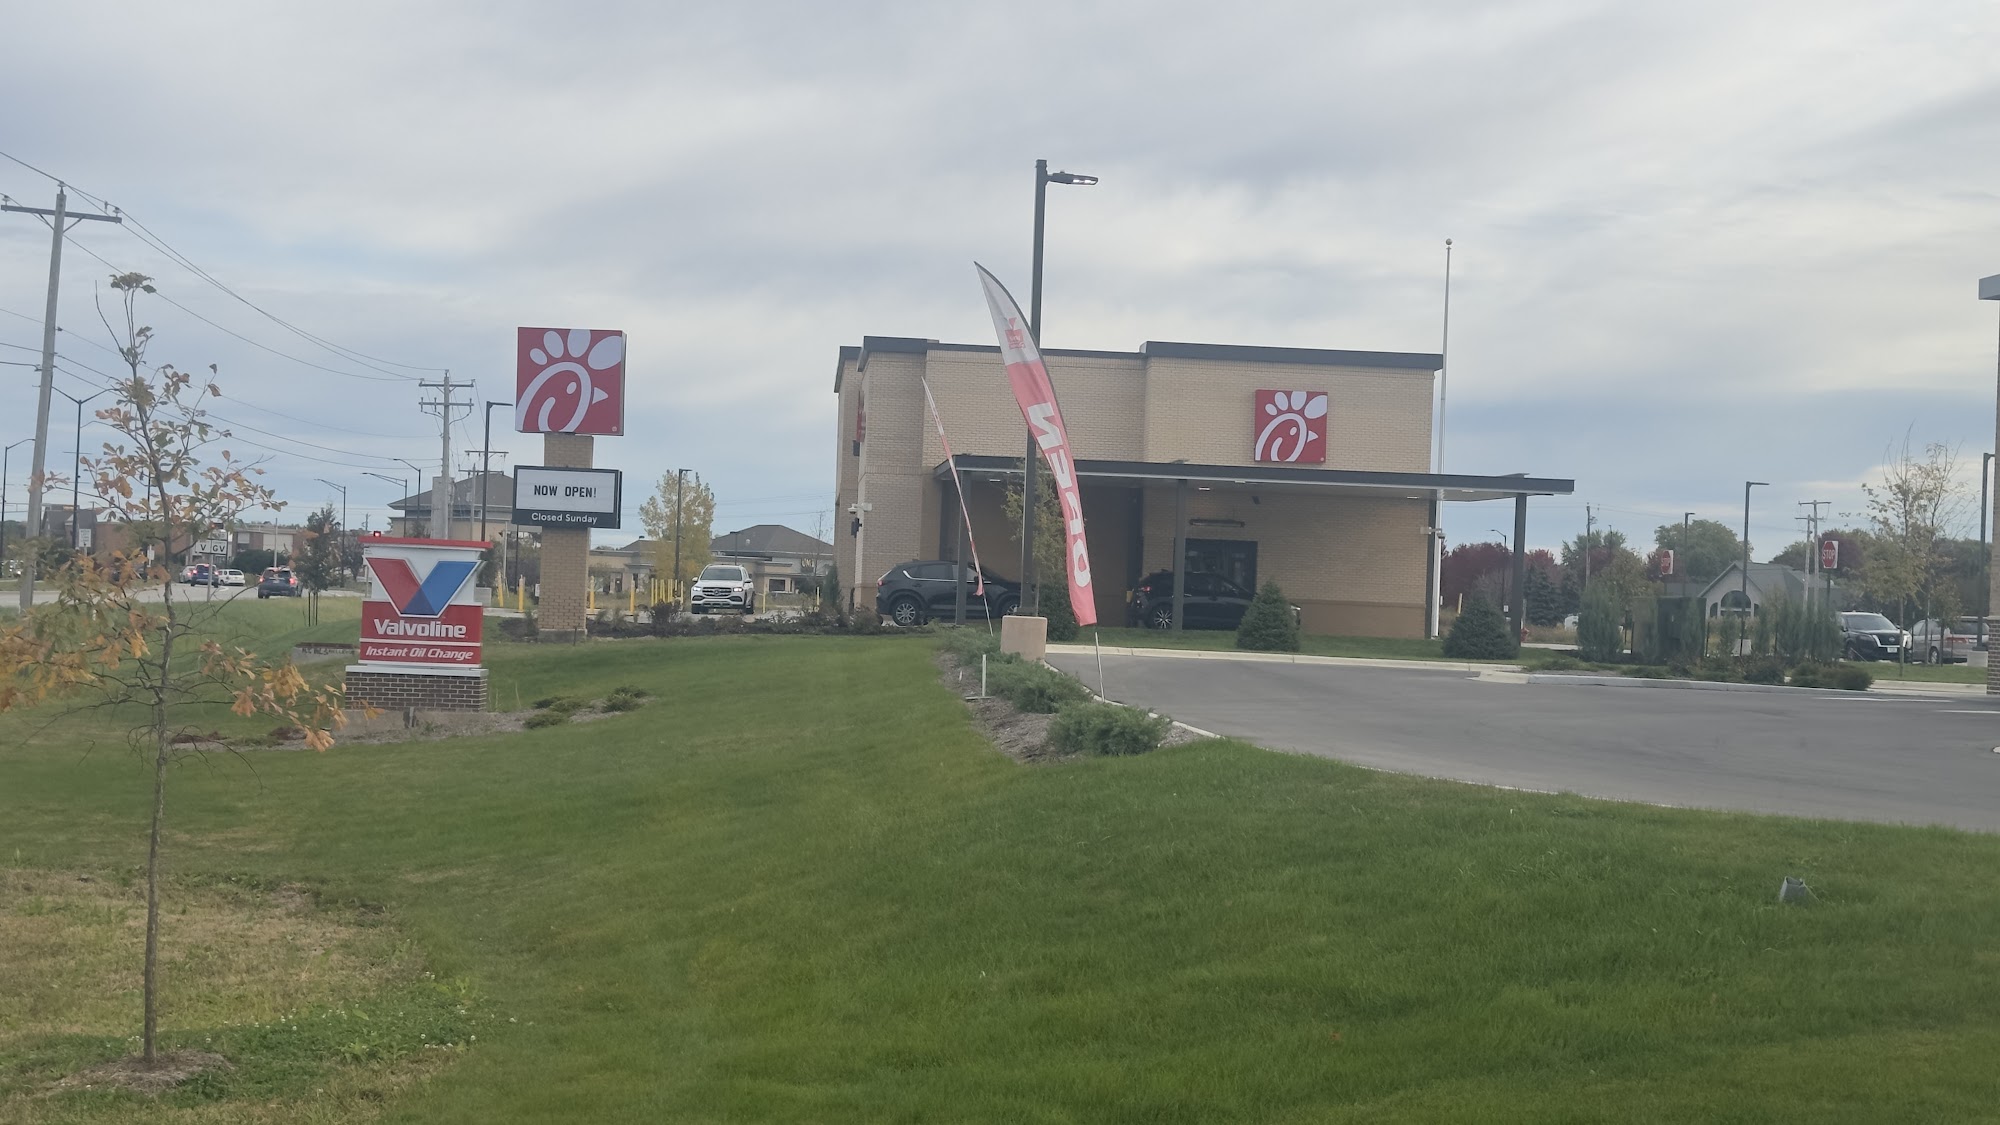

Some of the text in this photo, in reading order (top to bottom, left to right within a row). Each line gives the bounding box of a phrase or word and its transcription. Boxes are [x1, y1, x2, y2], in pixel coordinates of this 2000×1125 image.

[534, 485, 597, 498] NOW OPEN!
[531, 512, 598, 525] Closed Sunday
[212, 544, 225, 552] GV
[1822, 549, 1835, 560] STOP
[373, 618, 467, 639] Valvoline
[366, 645, 407, 657] Instant
[409, 647, 427, 657] Oil
[427, 648, 474, 660] Change
